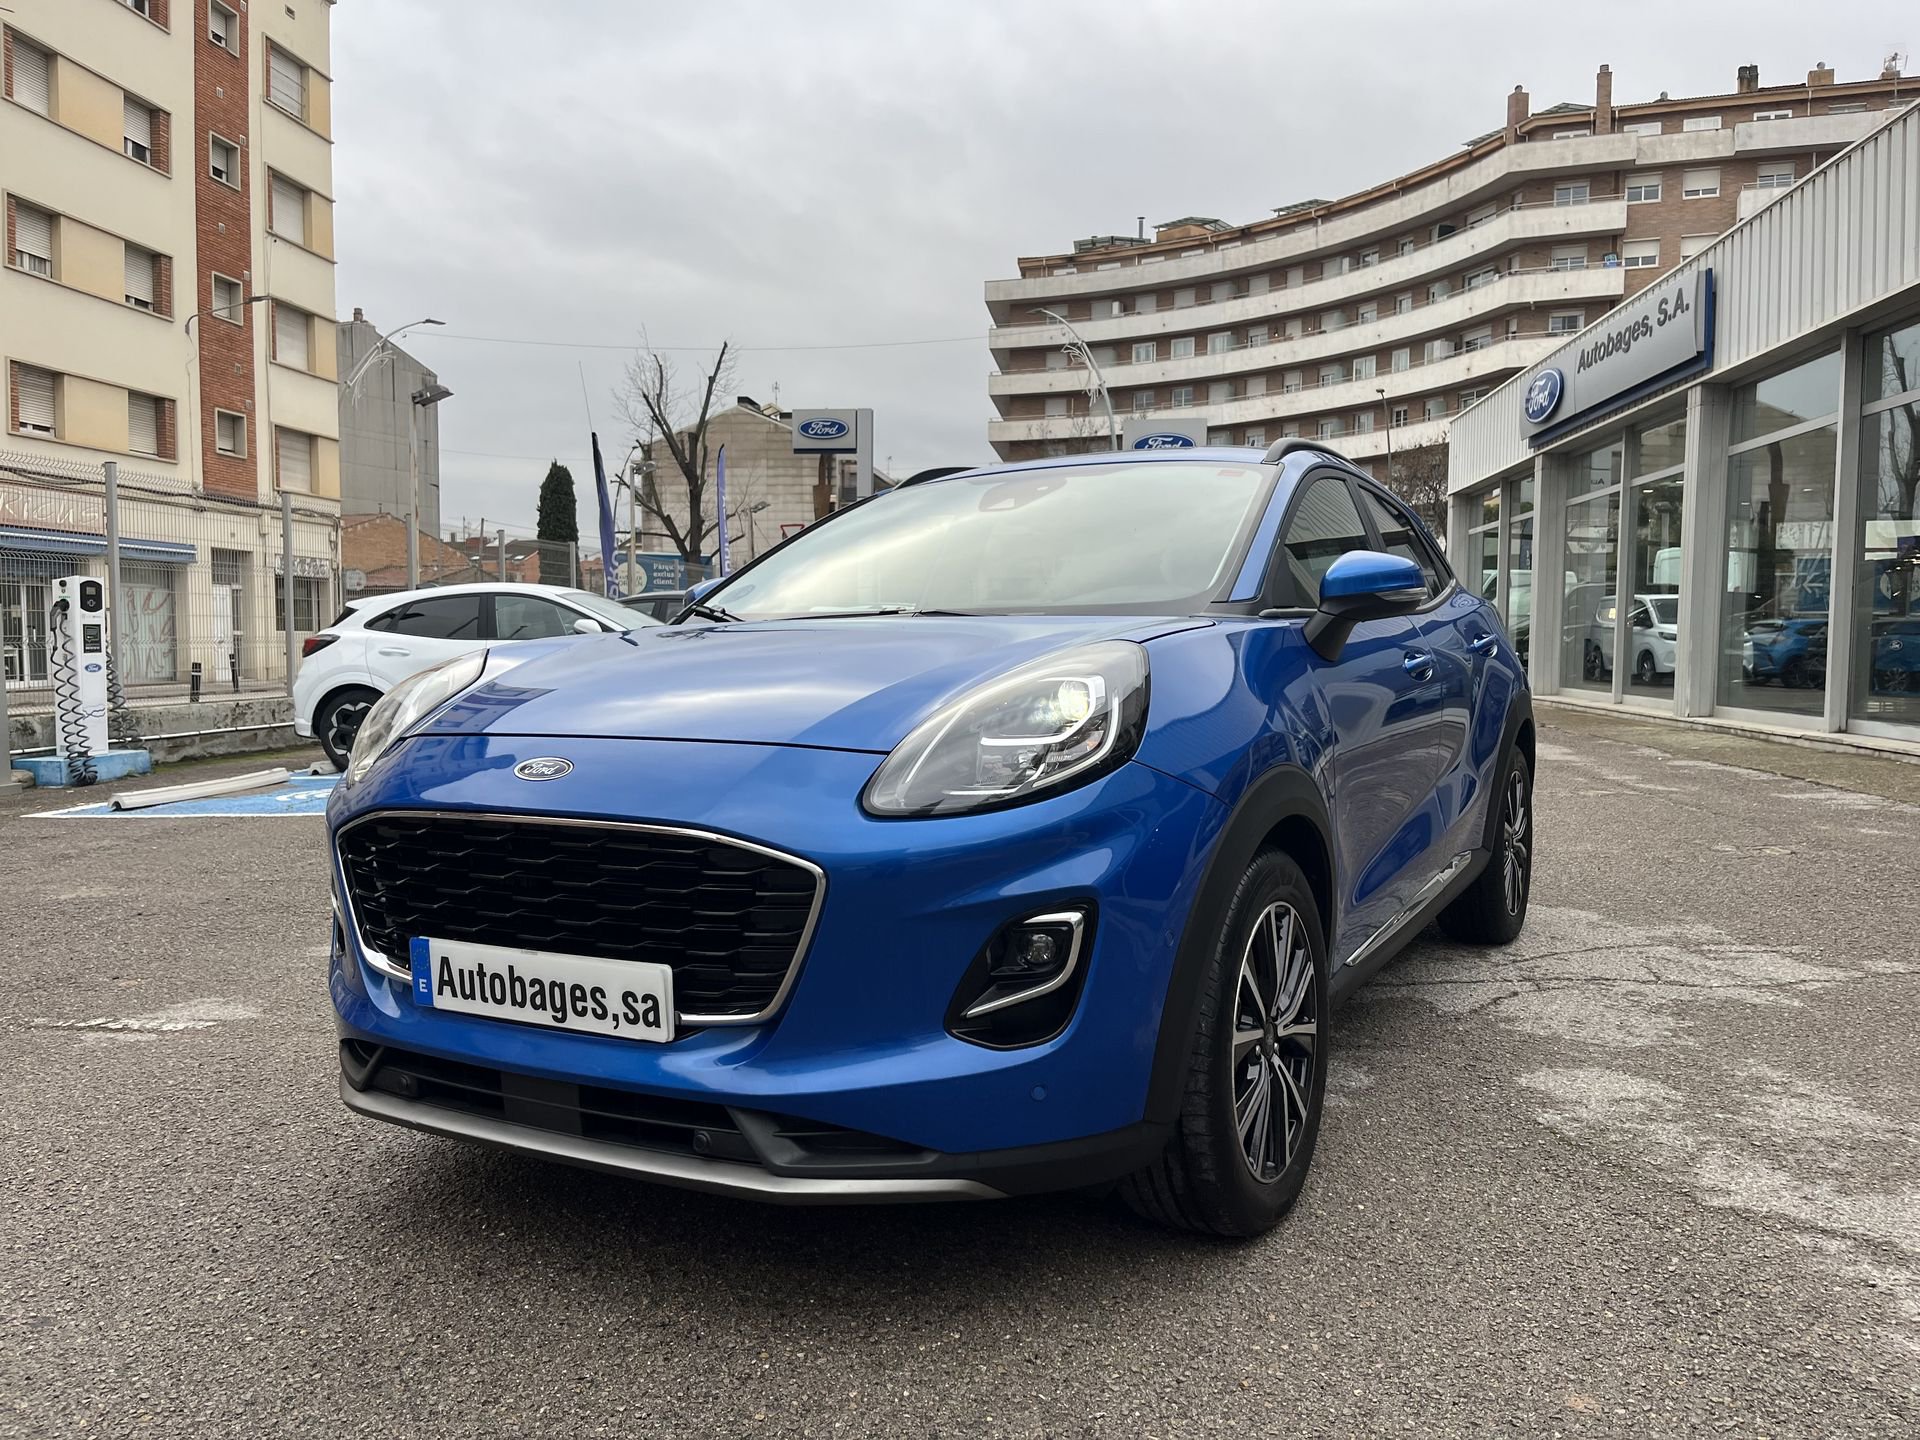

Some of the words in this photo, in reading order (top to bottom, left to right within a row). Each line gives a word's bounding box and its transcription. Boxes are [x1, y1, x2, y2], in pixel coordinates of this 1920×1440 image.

[1577, 315, 1653, 374] Autobages,
[1657, 287, 1690, 327] S.A.
[1528, 378, 1552, 414] Ford
[808, 421, 839, 435] Ford
[524, 761, 560, 775] Ford
[418, 978, 428, 993] E
[437, 956, 662, 1030] Autobages,sa
